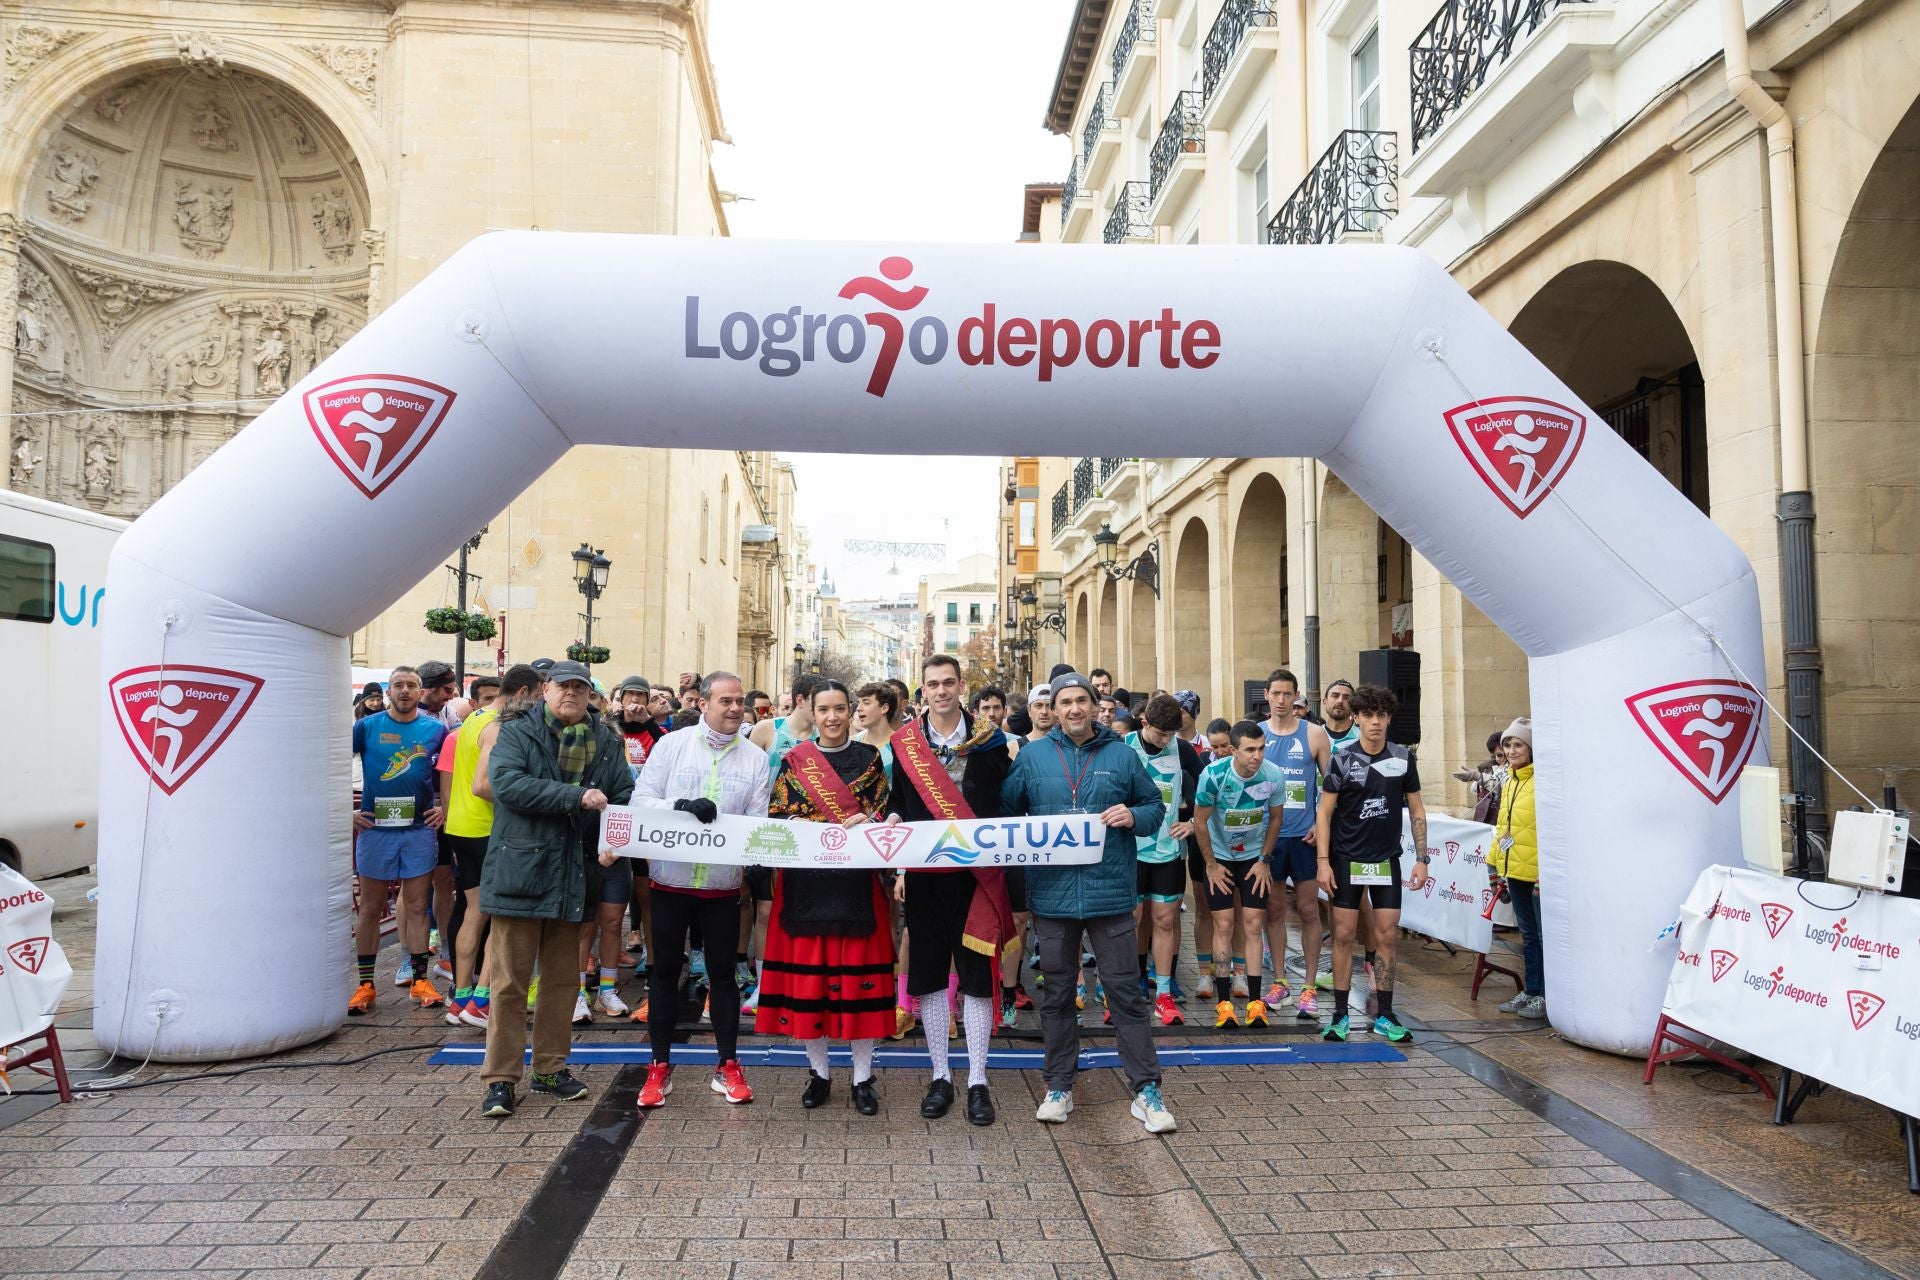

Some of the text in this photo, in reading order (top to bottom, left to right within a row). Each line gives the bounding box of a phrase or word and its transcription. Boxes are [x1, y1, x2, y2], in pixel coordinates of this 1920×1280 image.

[957, 303, 1221, 382] deporte
[324, 395, 425, 413] Logroño deporte
[1474, 417, 1569, 432] Logroño deporte
[125, 688, 230, 702] Logroño deporte
[1659, 701, 1753, 718] Logroño deporte
[388, 807, 402, 818] 32
[1239, 816, 1251, 825] 74
[638, 824, 726, 849] Logroño
[924, 822, 1101, 864] ACTUAL
[994, 852, 1052, 863] SPORT
[1361, 863, 1380, 875] 281
[1456, 890, 1474, 904] deporte
[1784, 983, 1828, 1008] deporte
